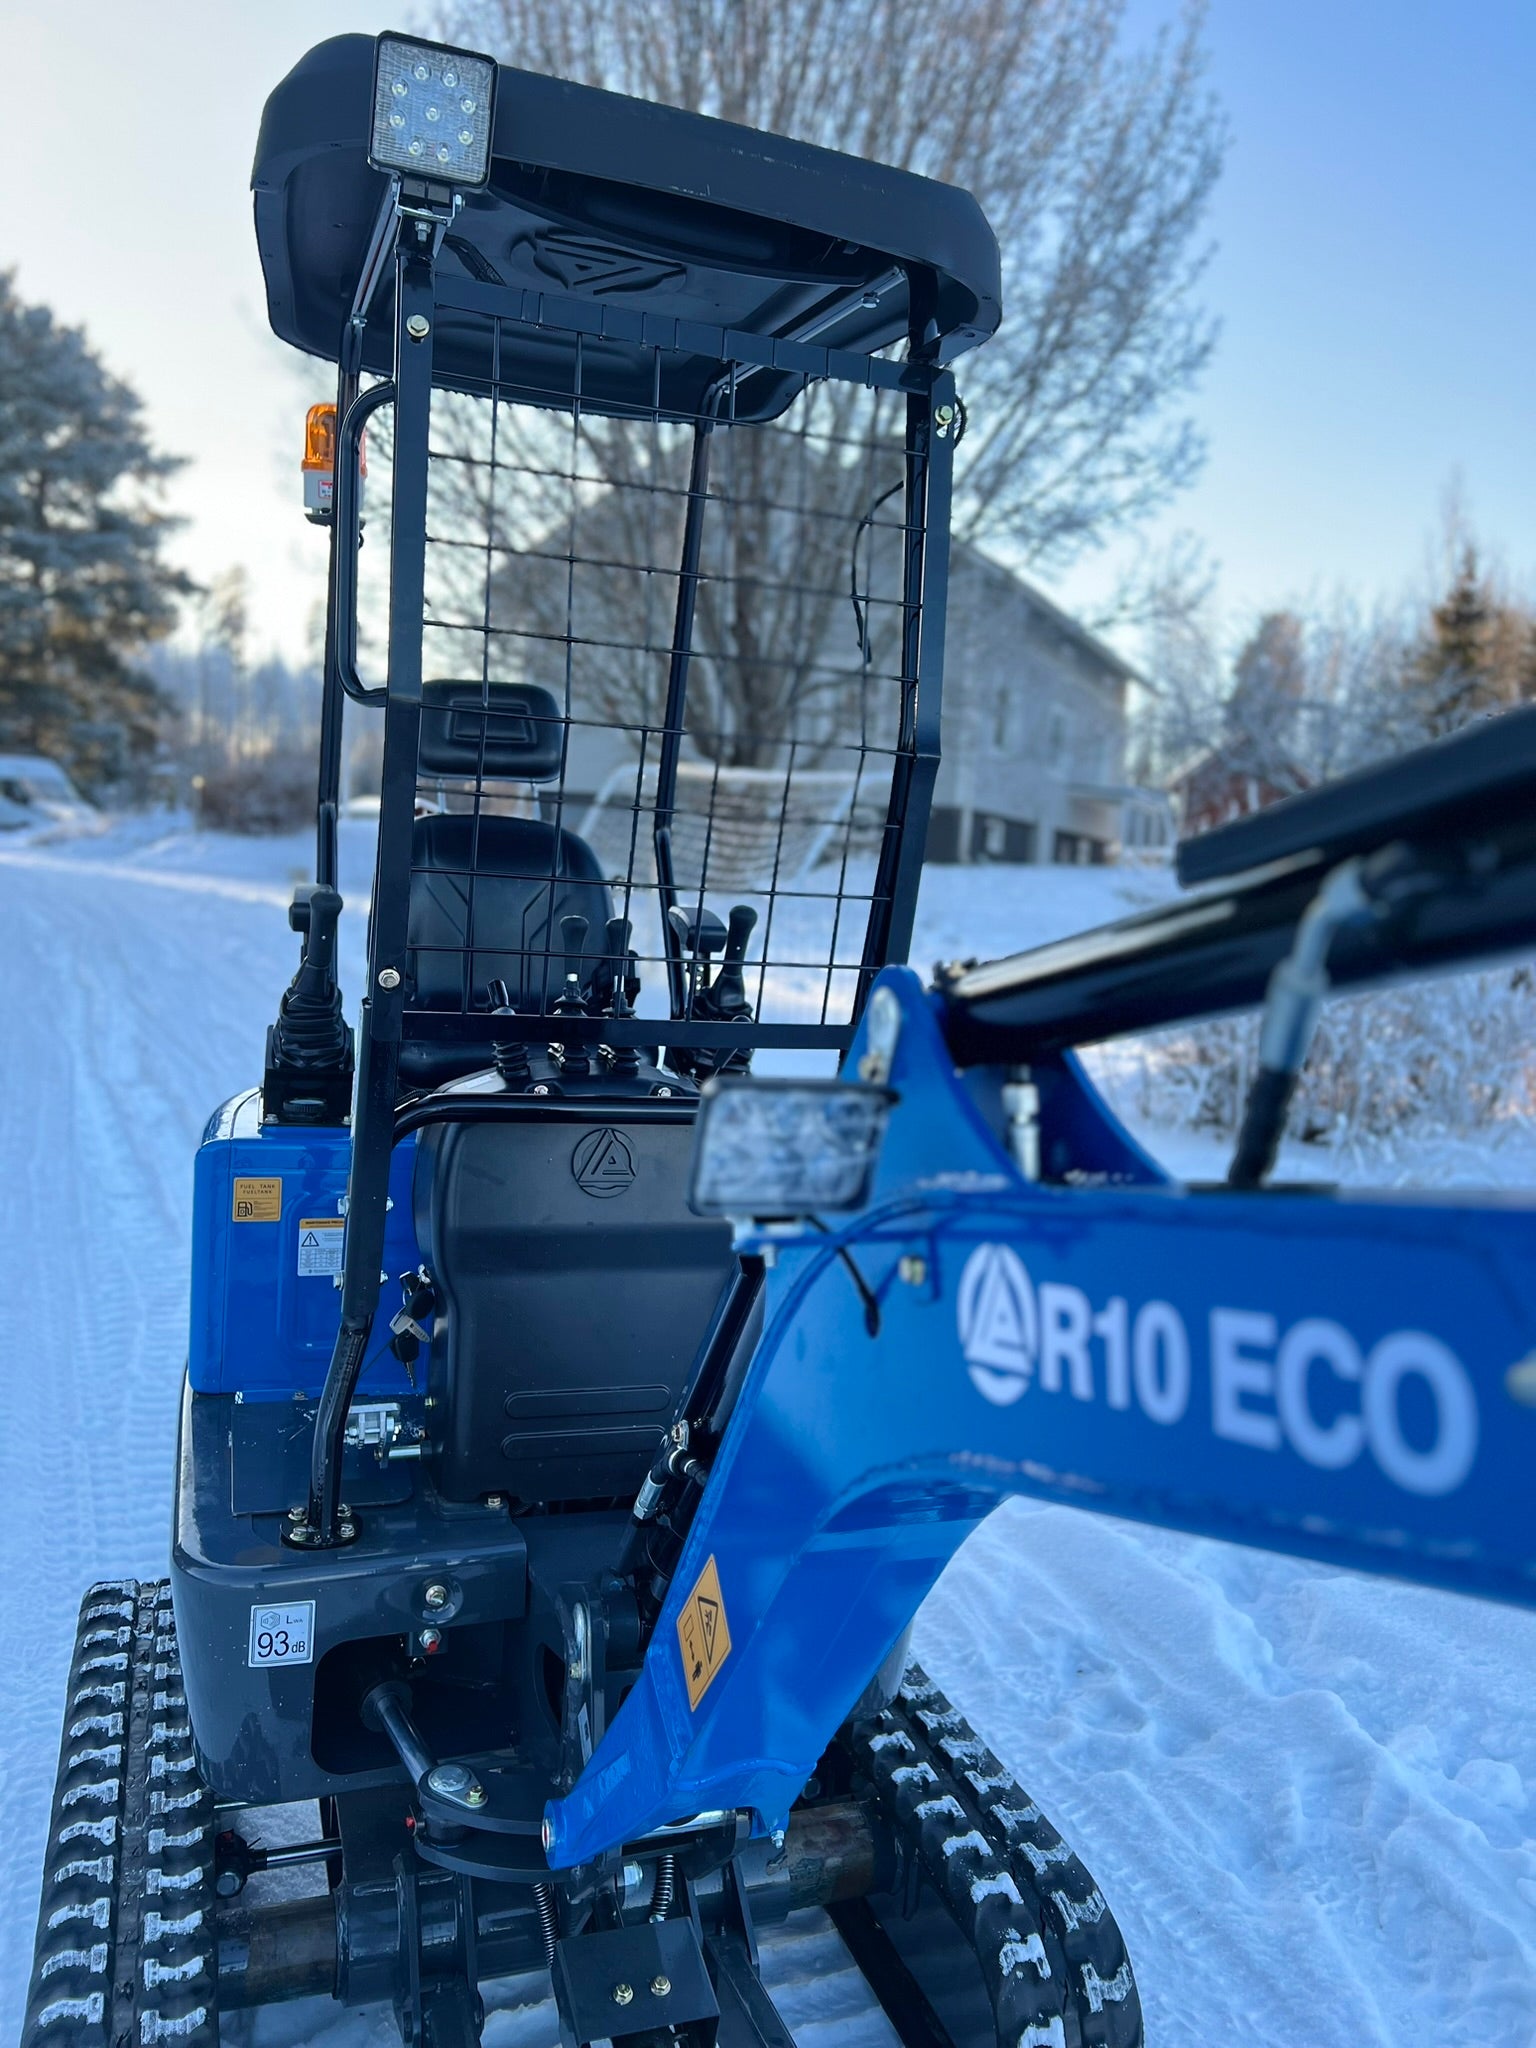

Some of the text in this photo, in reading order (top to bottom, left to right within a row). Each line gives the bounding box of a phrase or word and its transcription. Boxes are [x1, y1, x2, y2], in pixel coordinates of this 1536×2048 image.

[1037, 1281, 1479, 1497] R10 ECO
[257, 1630, 306, 1658] 93 dB
